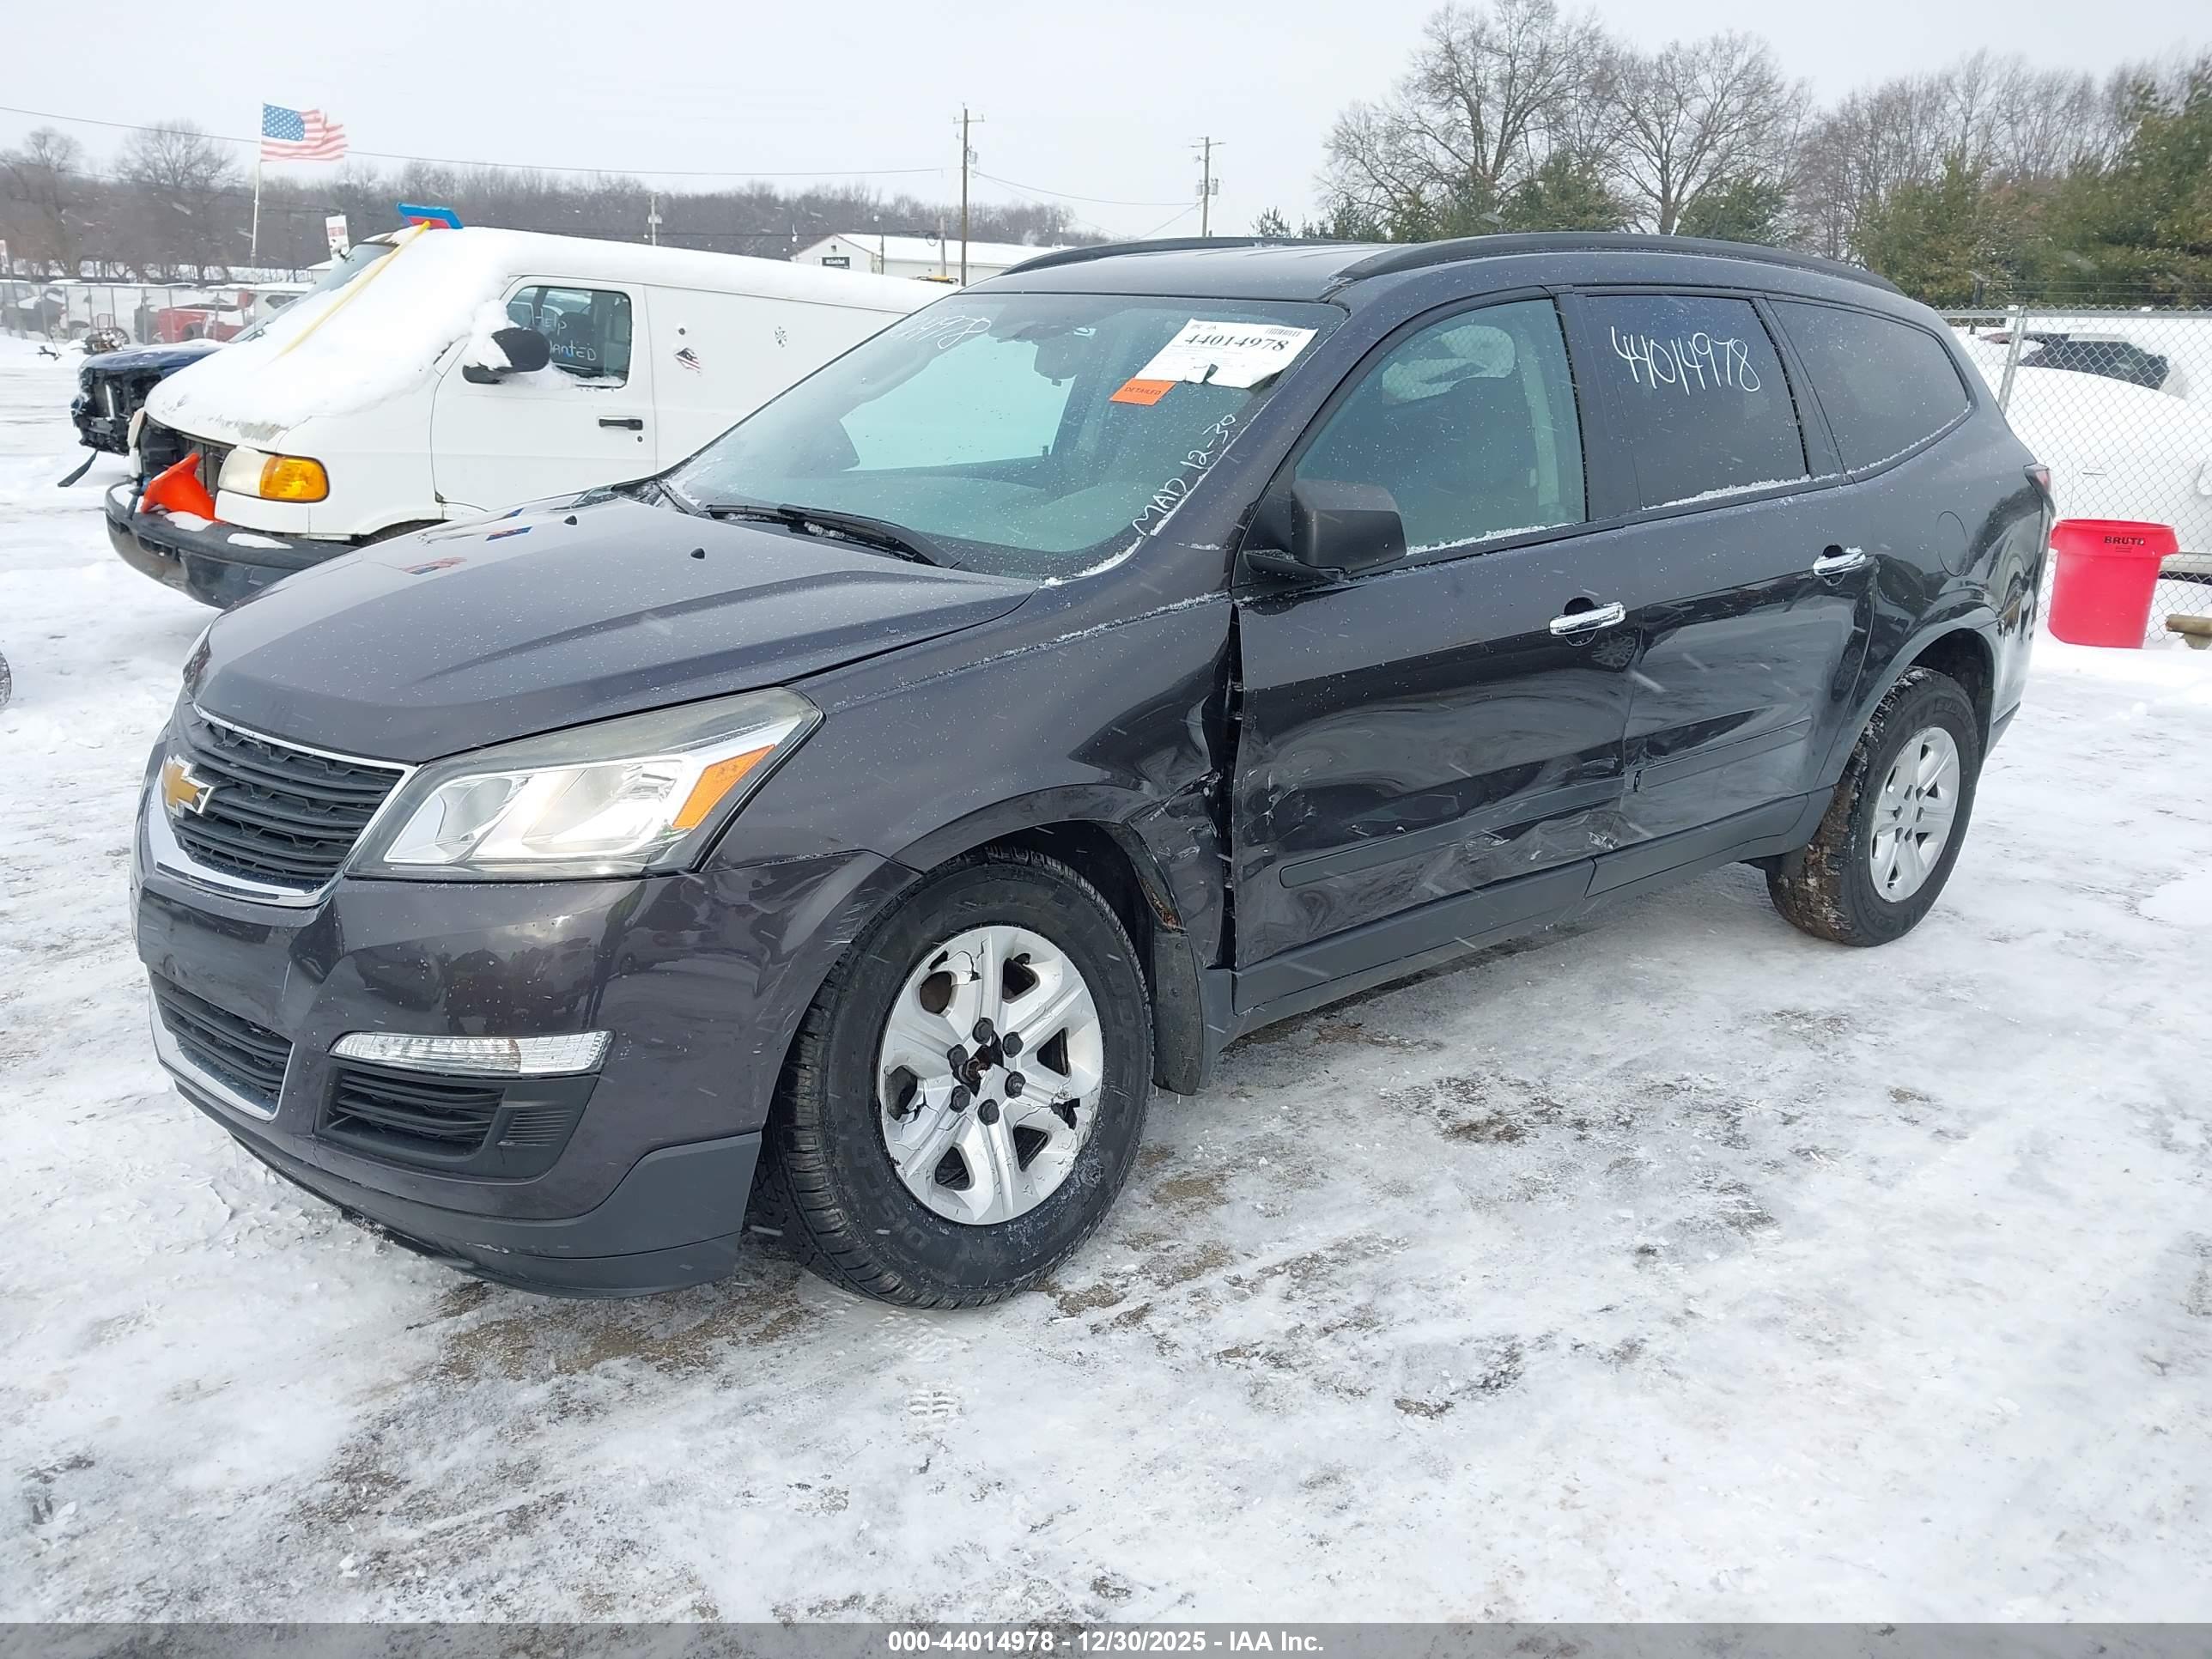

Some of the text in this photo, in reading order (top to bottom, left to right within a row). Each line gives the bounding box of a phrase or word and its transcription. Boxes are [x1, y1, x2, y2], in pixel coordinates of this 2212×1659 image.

[1185, 333, 1290, 352] 44014978
[1611, 325, 1760, 396] 44014978
[1124, 386, 1162, 396] DETAILED
[1133, 477, 1187, 536] MAD
[1180, 413, 1237, 470] 12-30
